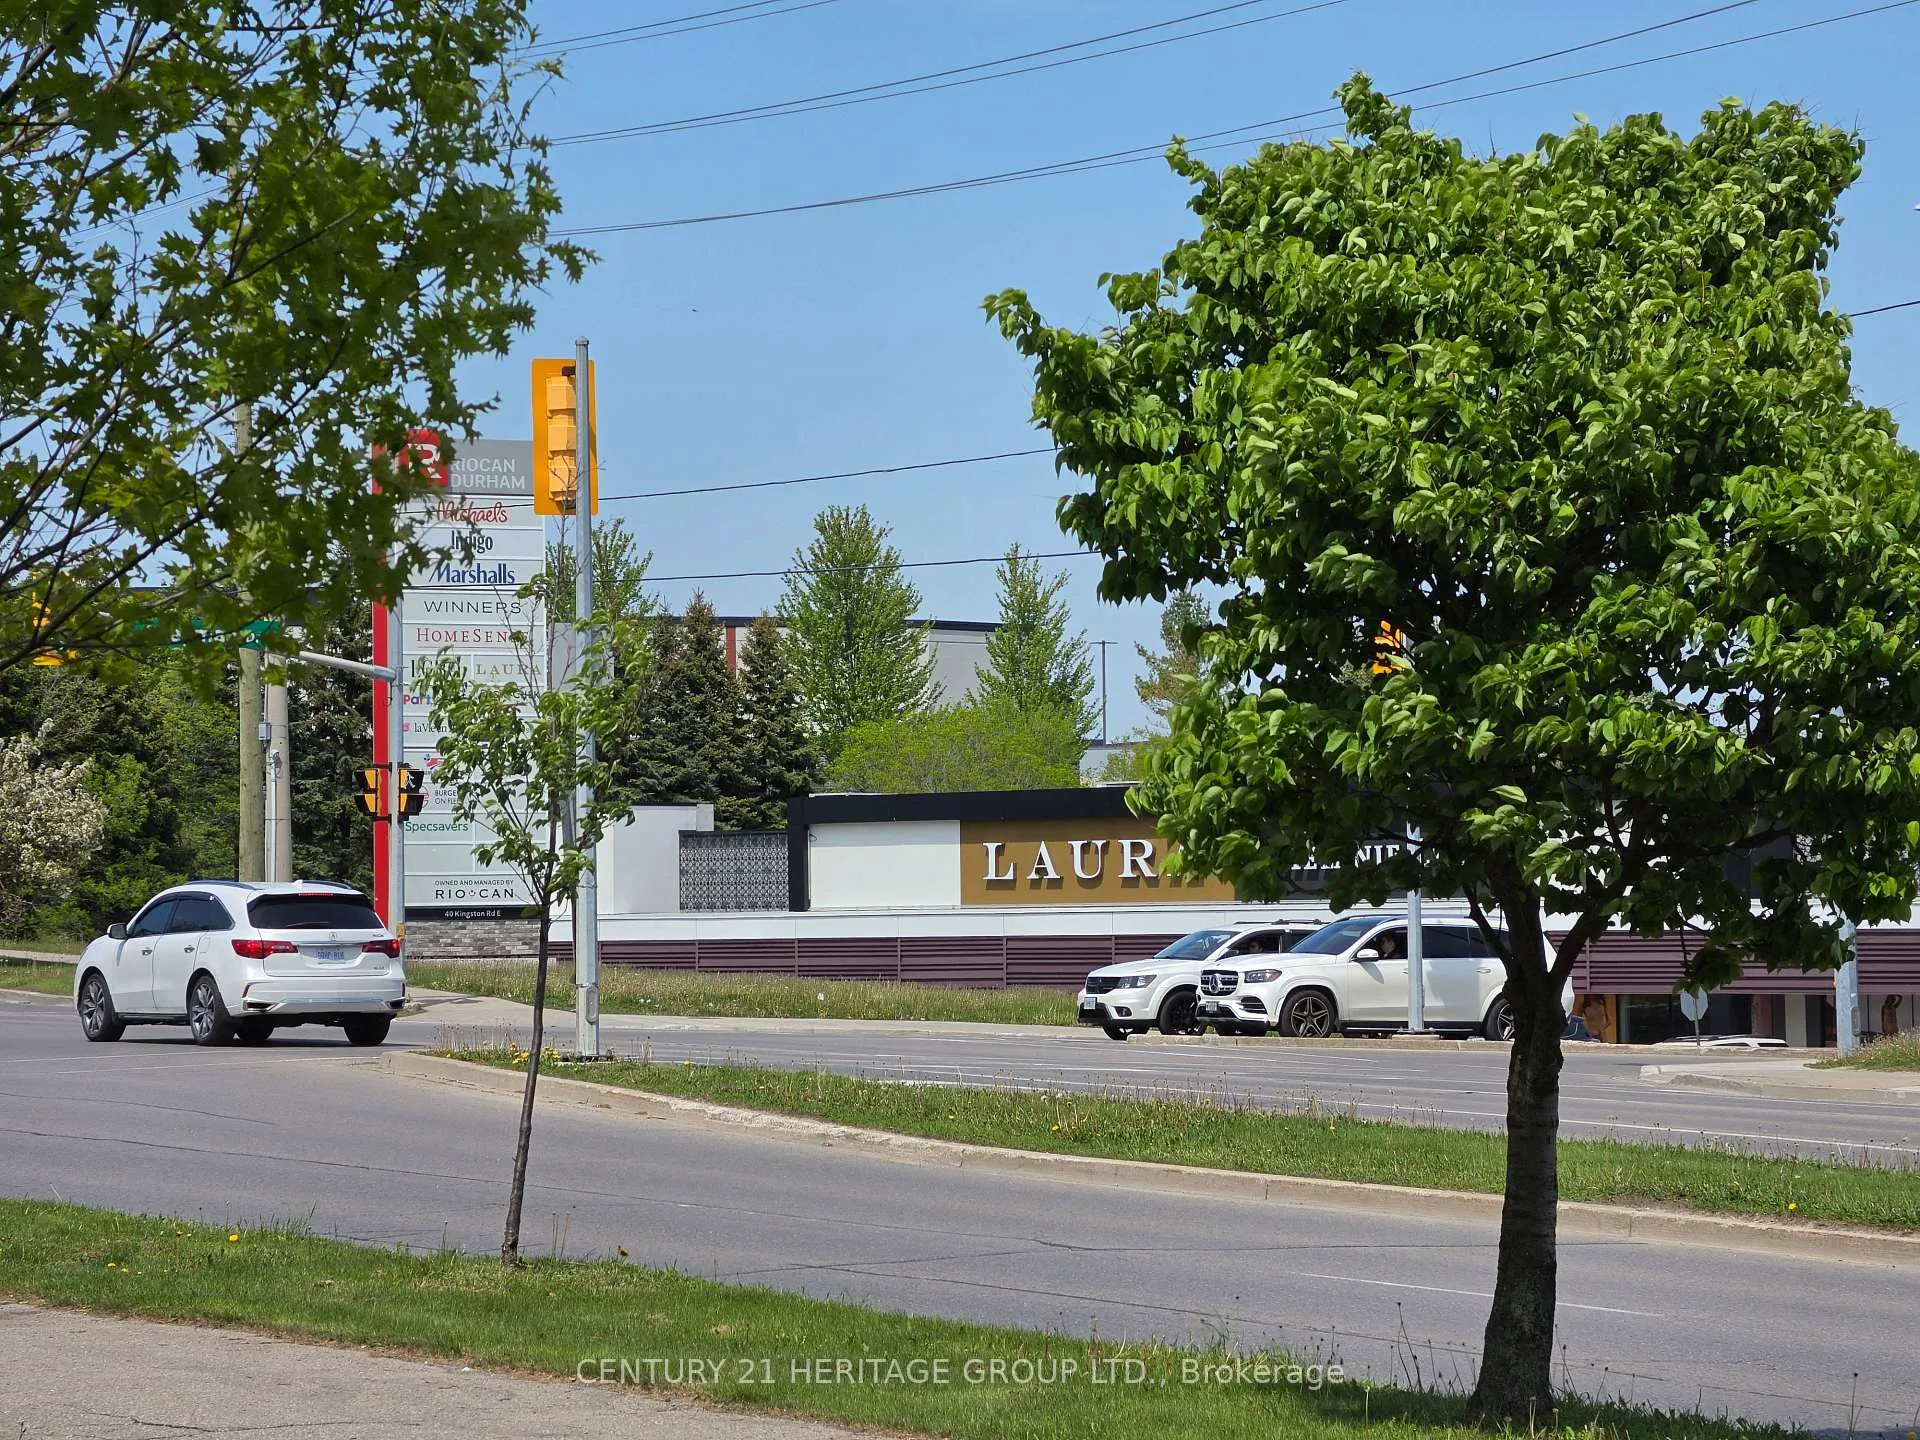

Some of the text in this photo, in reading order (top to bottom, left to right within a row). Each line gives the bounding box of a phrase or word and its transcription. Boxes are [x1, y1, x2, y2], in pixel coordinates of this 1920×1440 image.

[450, 458, 516, 473] RIOCAN
[450, 473, 525, 489] DURHAM
[428, 562, 516, 584] Marshalls
[423, 601, 522, 614] WINNERS
[475, 663, 542, 676] LAURA
[402, 694, 433, 705] Part
[434, 789, 457, 797] BURGE
[405, 821, 469, 833] Specsavers
[982, 838, 1183, 881] LAUR
[444, 910, 454, 918] 40
[454, 909, 486, 919] Kingston
